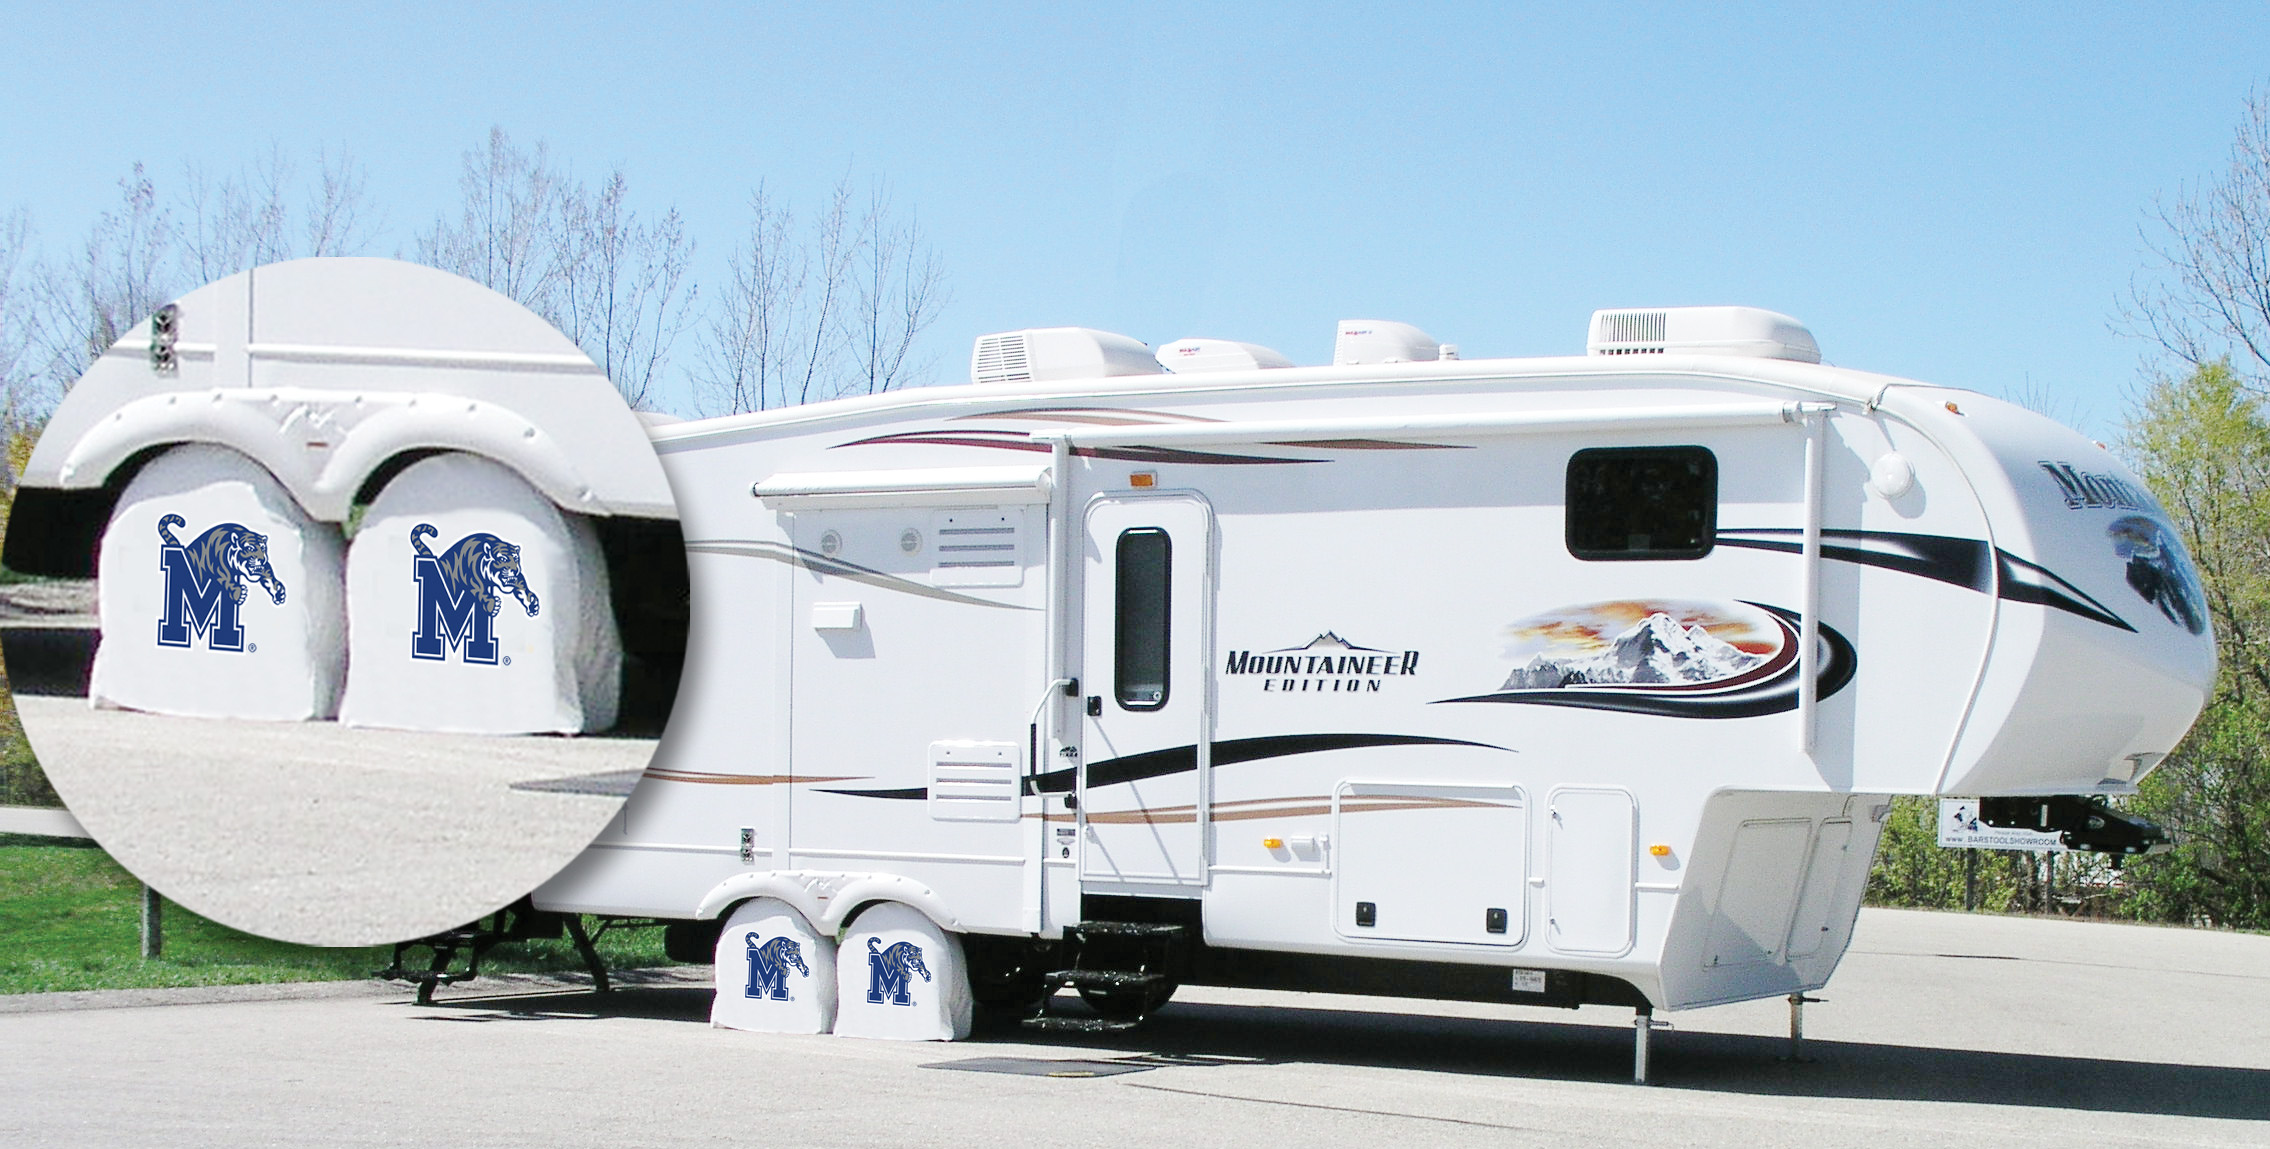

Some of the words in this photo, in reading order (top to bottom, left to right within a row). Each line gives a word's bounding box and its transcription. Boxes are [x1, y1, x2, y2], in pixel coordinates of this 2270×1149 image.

[157, 544, 246, 652] M
[412, 554, 499, 665] M
[1226, 650, 1419, 675] MOUNTAINEER
[1264, 678, 1381, 692] EDITION
[745, 947, 789, 1001] M
[867, 952, 910, 1006] M
